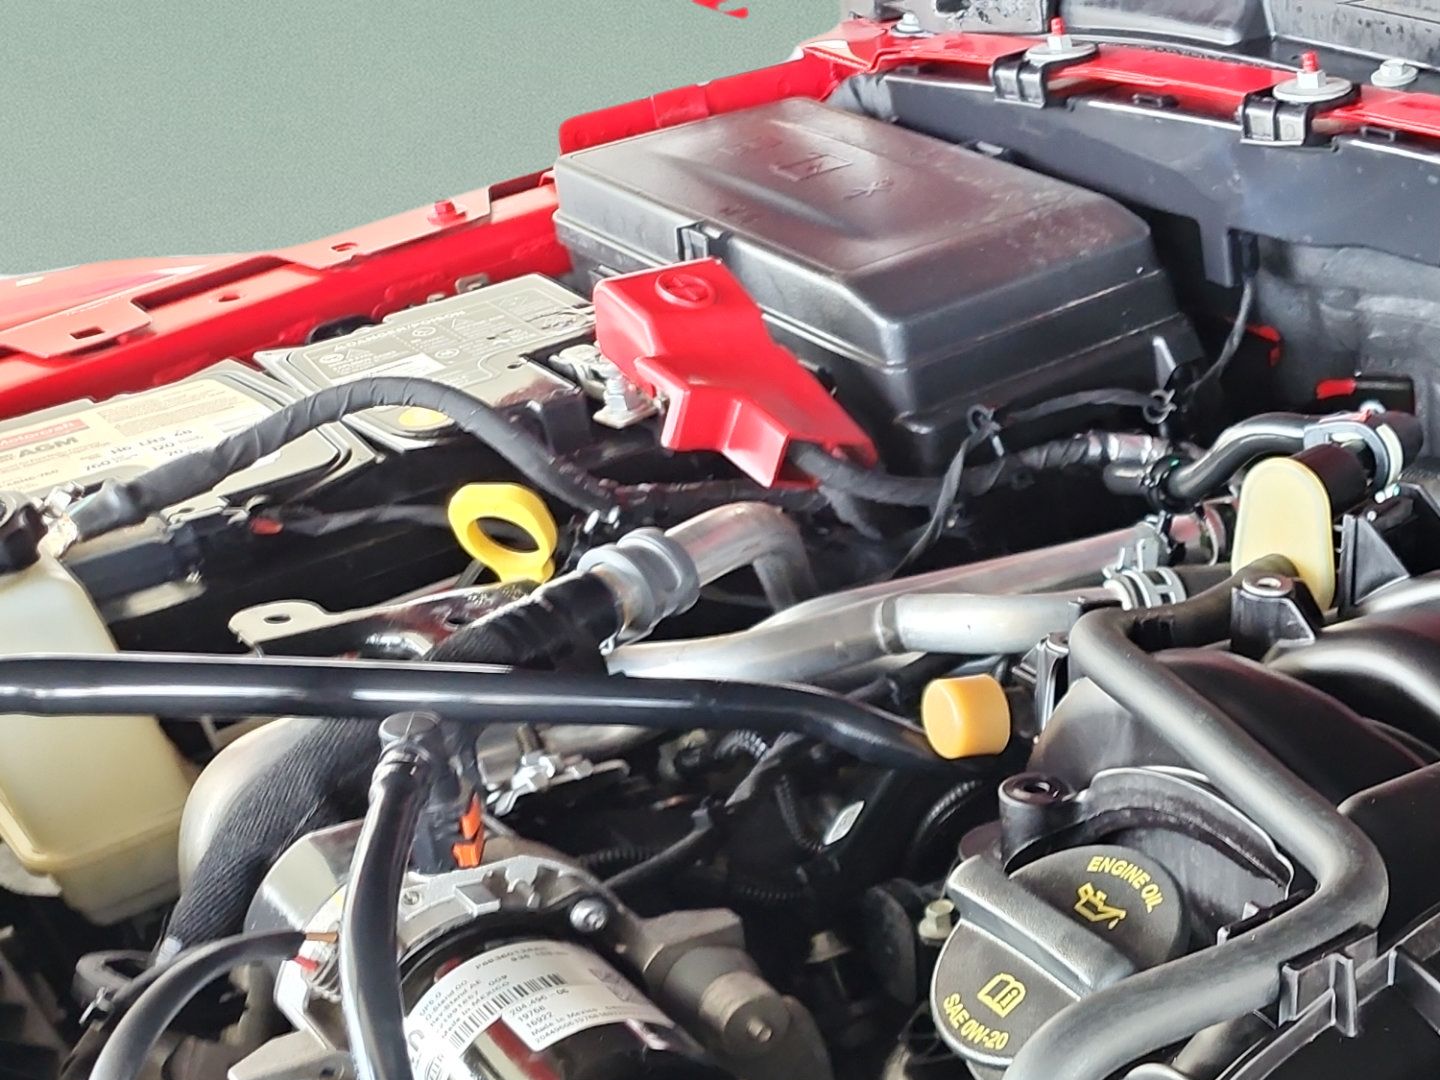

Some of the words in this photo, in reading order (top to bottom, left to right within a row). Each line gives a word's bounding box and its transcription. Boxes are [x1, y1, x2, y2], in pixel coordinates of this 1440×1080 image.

[19, 436, 79, 457] AGM
[1087, 856, 1148, 890] ENGINE
[1140, 882, 1164, 914] OIL
[943, 993, 967, 1025] SAE
[960, 1019, 1010, 1050] 0W-20
